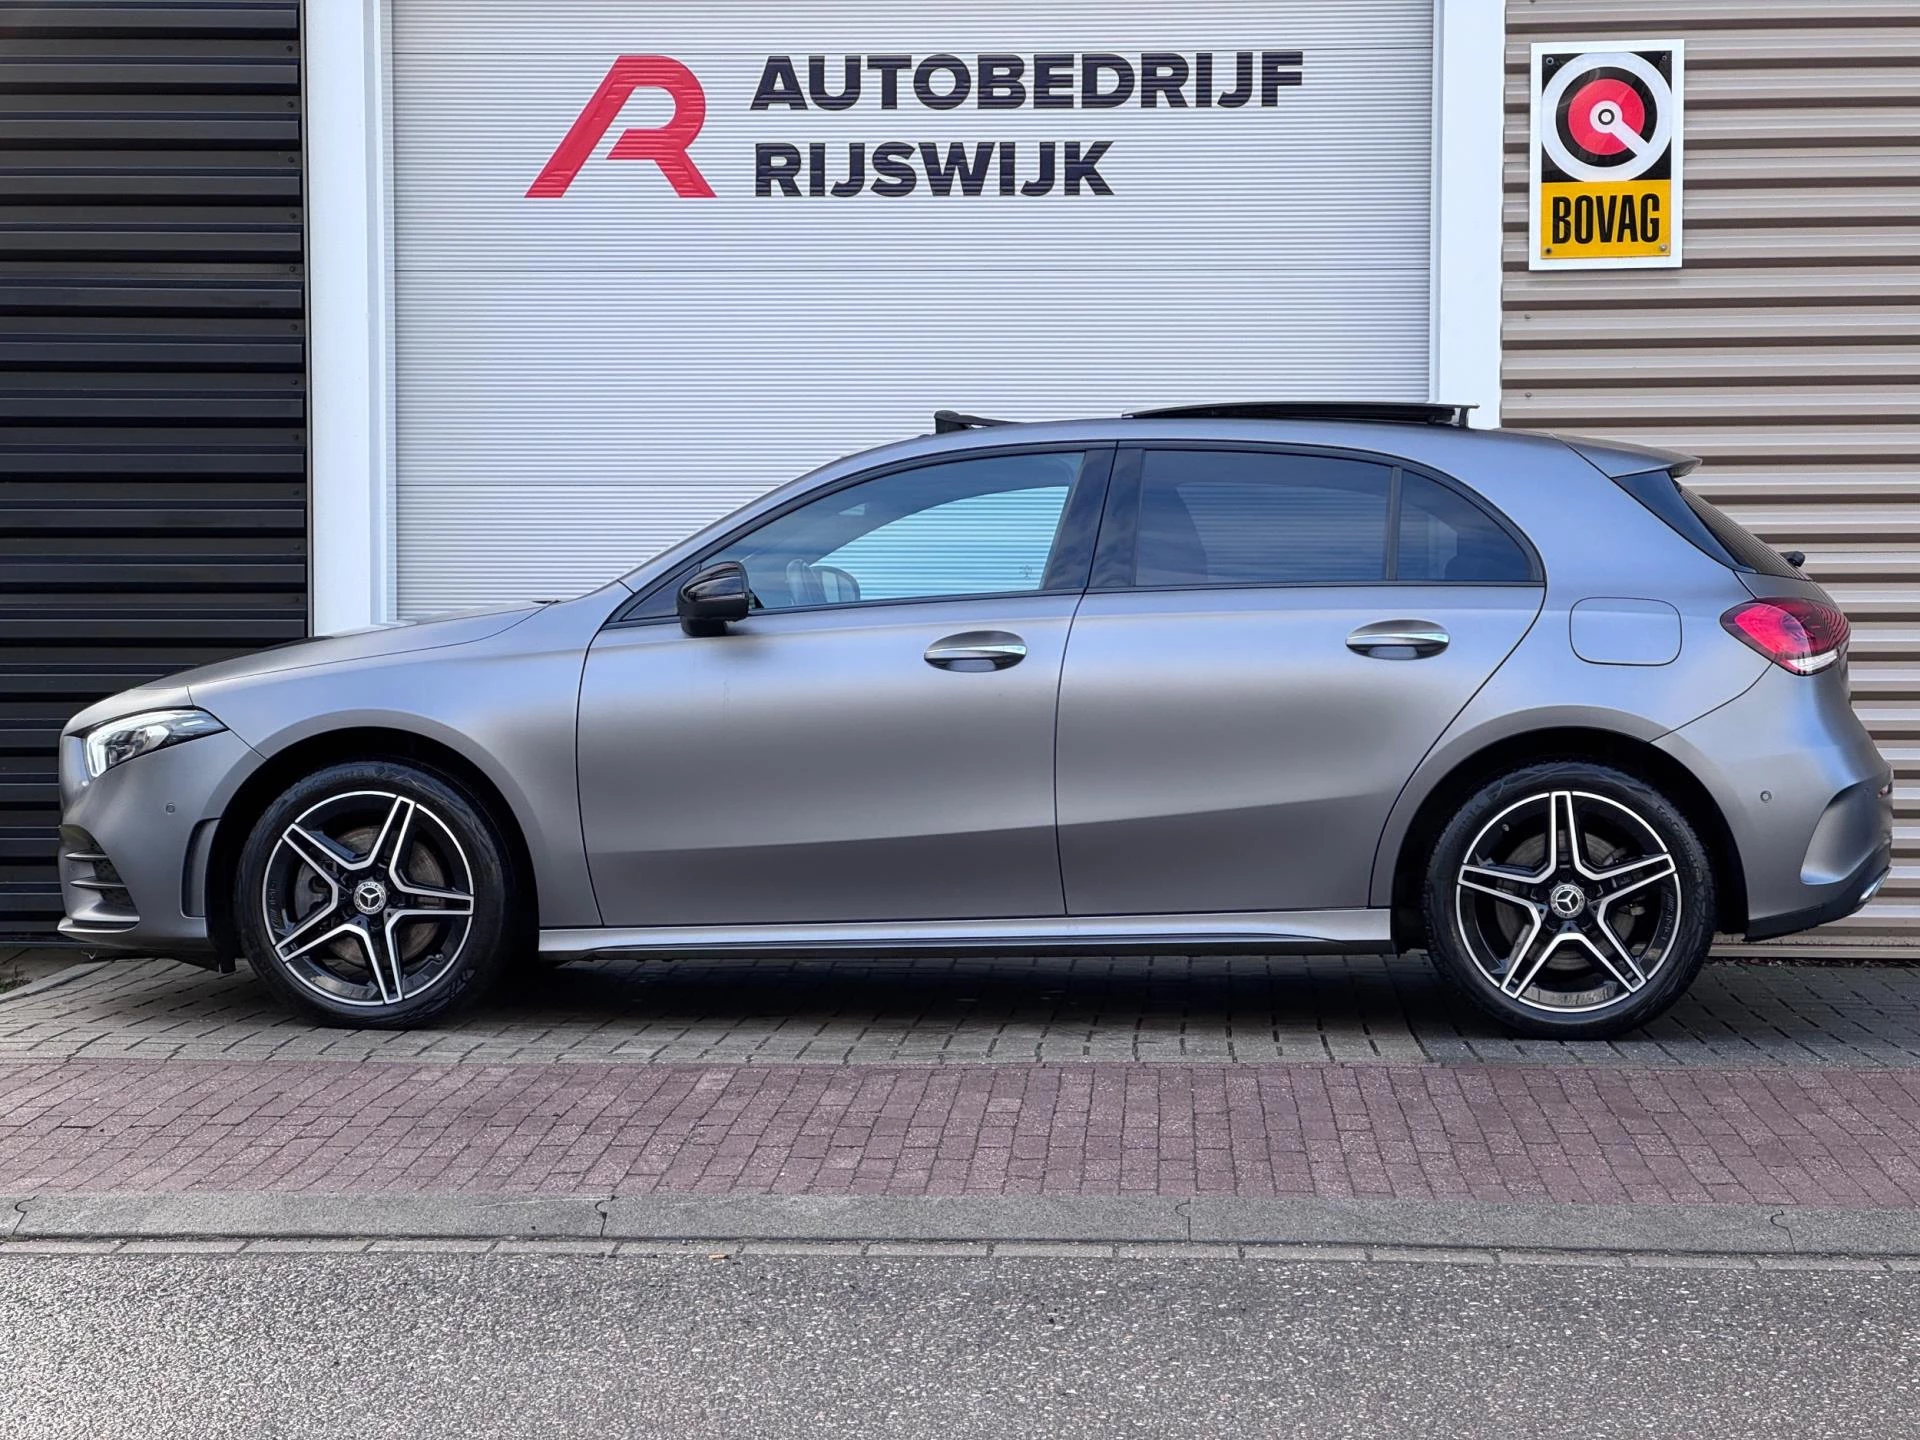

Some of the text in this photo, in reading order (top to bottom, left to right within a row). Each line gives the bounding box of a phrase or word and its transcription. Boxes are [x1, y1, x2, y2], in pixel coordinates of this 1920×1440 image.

[750, 51, 1303, 111] AUTOBEDRIJF
[755, 140, 1114, 198] RIJSWIJK
[1552, 193, 1660, 244] BOVAG
